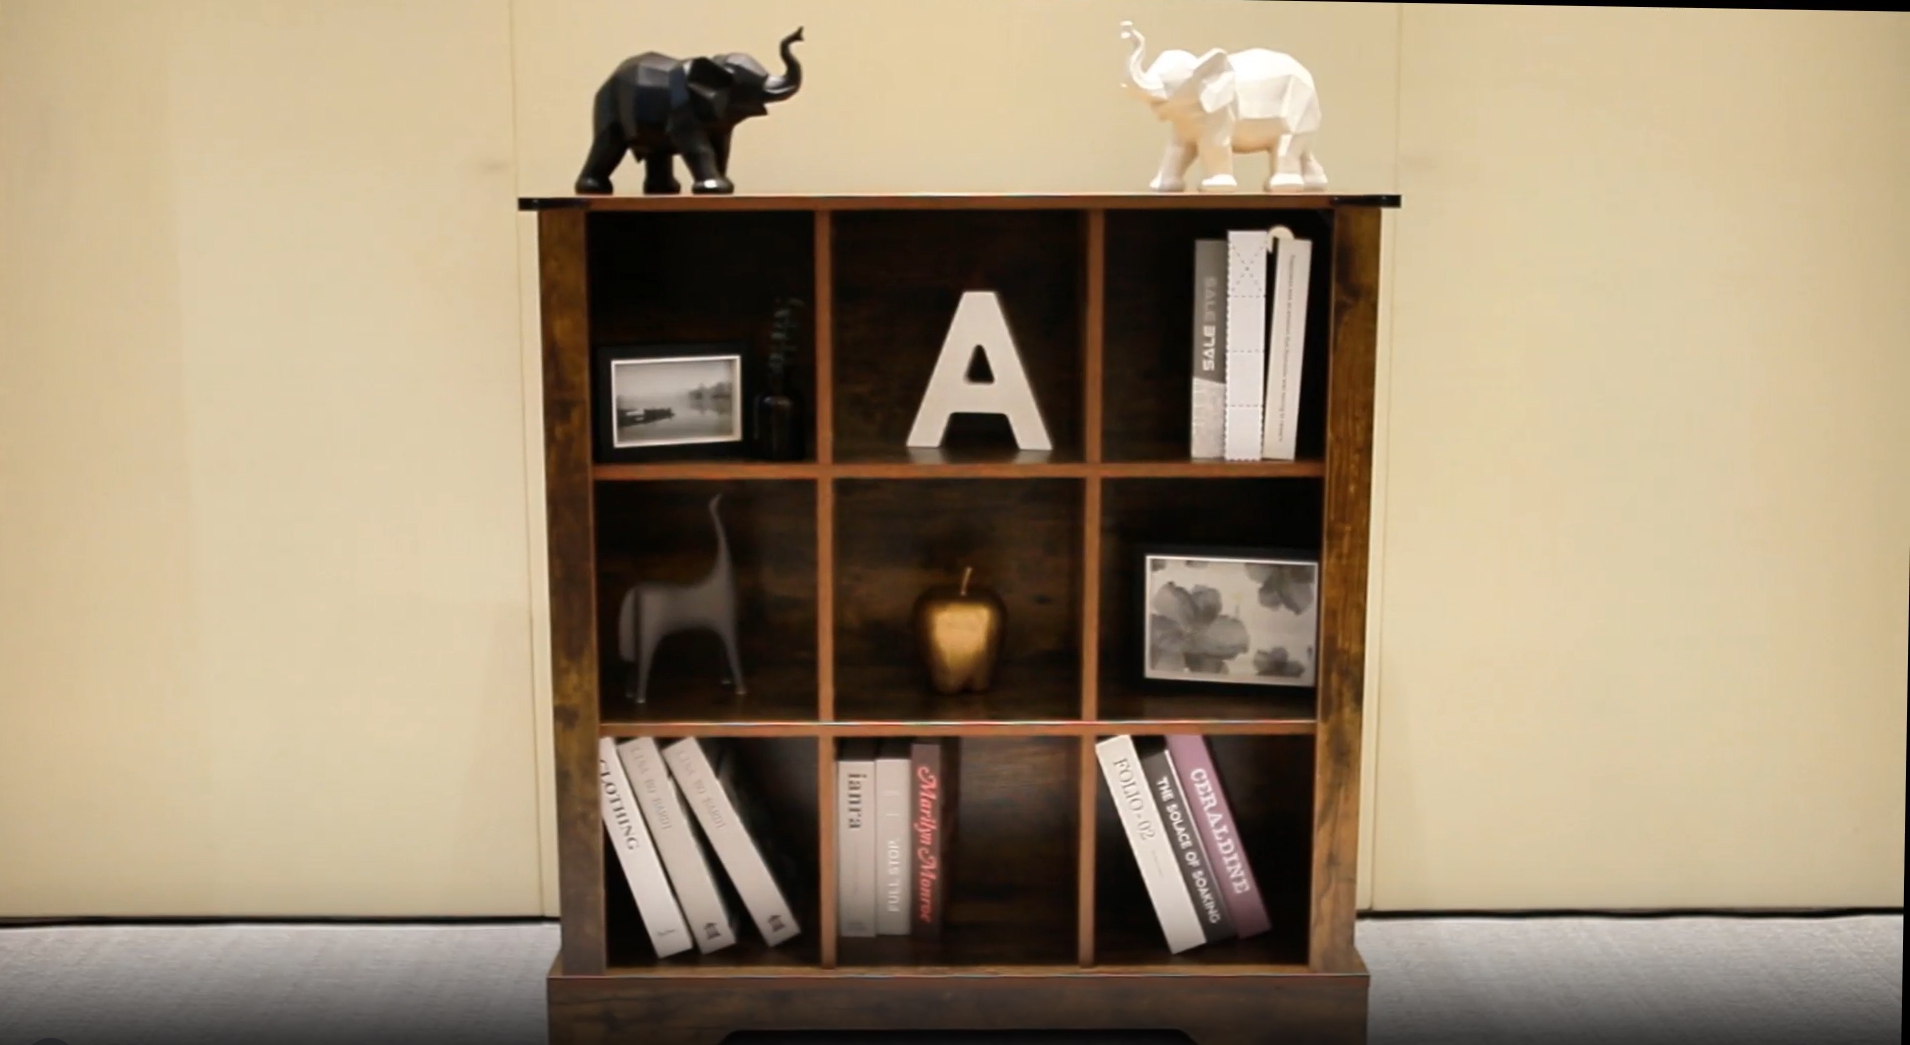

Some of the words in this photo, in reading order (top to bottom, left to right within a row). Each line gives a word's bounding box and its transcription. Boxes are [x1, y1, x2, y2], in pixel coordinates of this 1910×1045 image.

[906, 291, 1053, 450] A
[1203, 325, 1216, 372] SALE
[913, 766, 938, 846] Marilyn
[1156, 776, 1173, 804] THE
[1165, 804, 1192, 850] SOLACE
[1185, 851, 1200, 869] OF
[888, 881, 900, 912] FULL
[917, 848, 937, 923] Monroe
[1192, 870, 1221, 925] SOAKING
